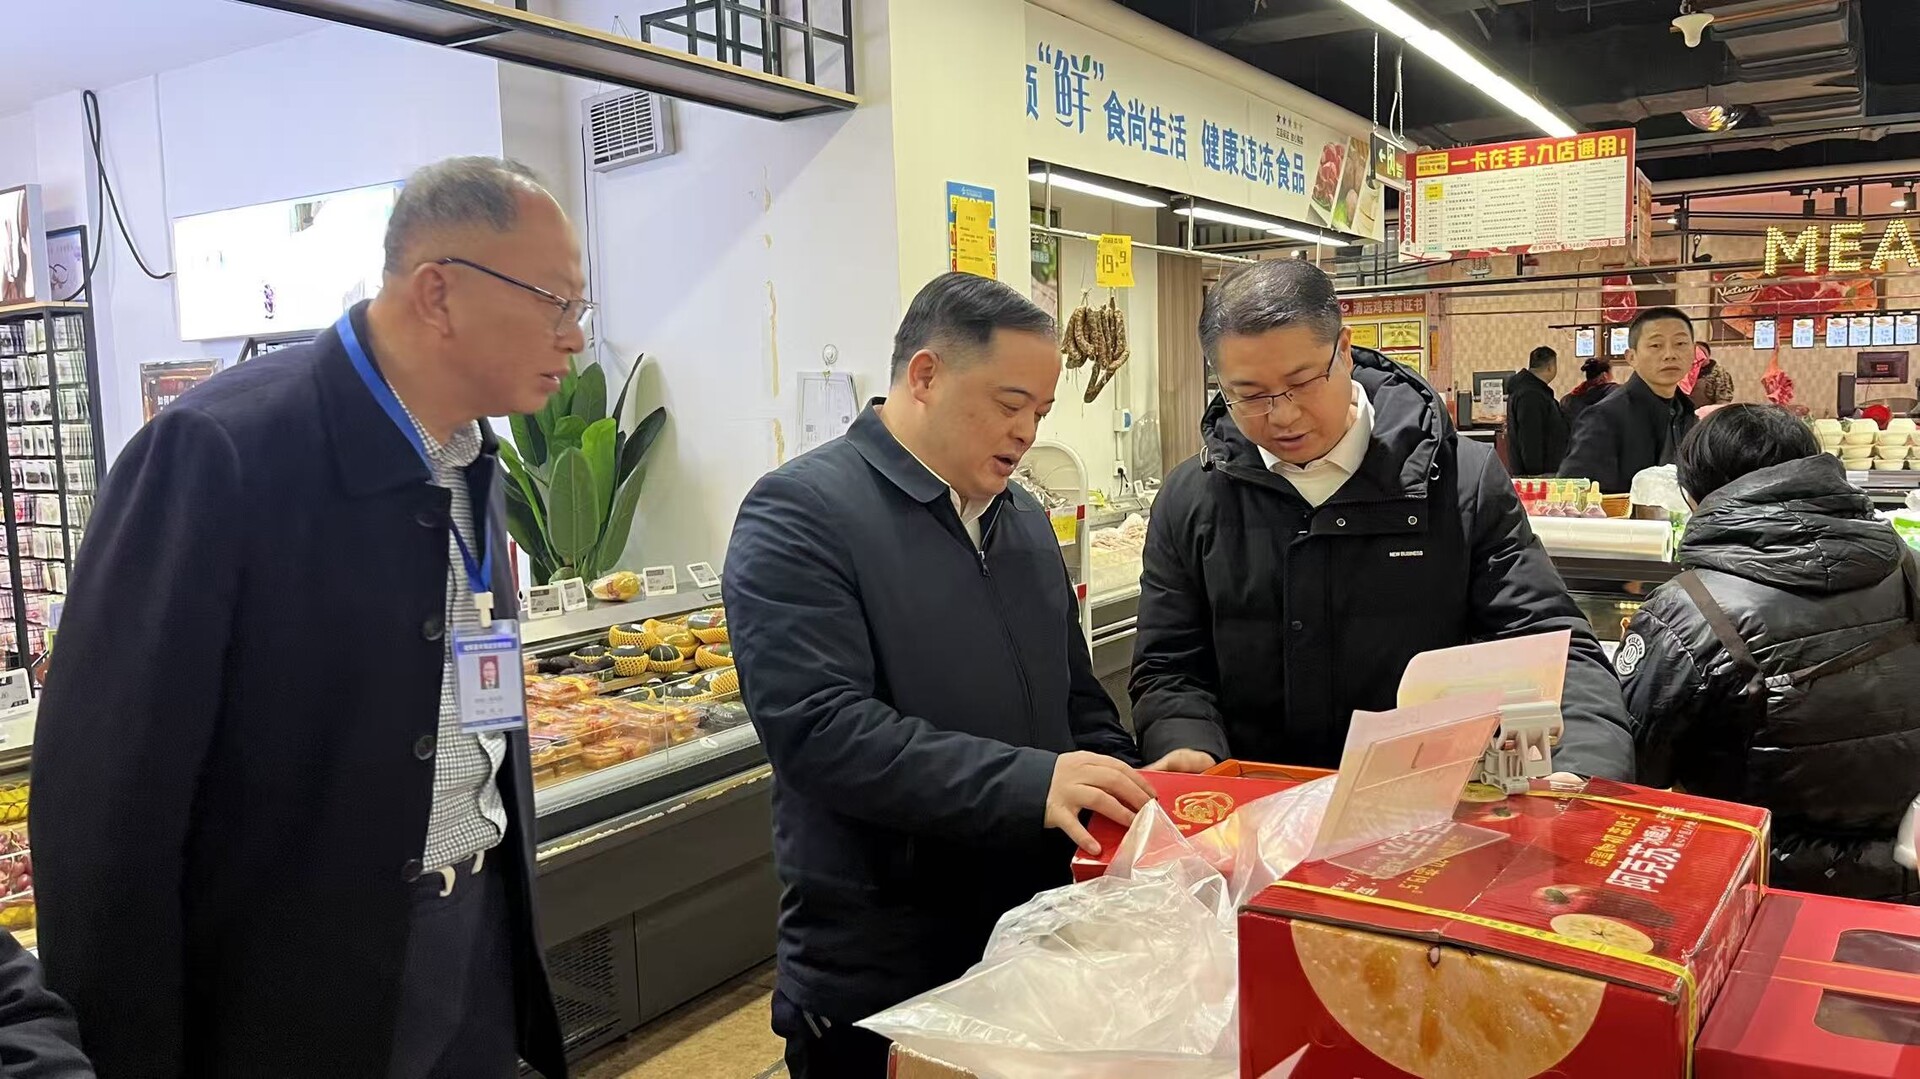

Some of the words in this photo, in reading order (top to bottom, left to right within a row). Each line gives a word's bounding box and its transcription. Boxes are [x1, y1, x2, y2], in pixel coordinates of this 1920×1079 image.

[1201, 118, 1305, 196] 健康速冻食品
[1451, 135, 1627, 171] 一卡在手,九店通用!
[1764, 219, 1920, 276] MEA
[1353, 298, 1424, 315] 清远鸡荣誉证书
[1605, 842, 1681, 893] 阿克苏
